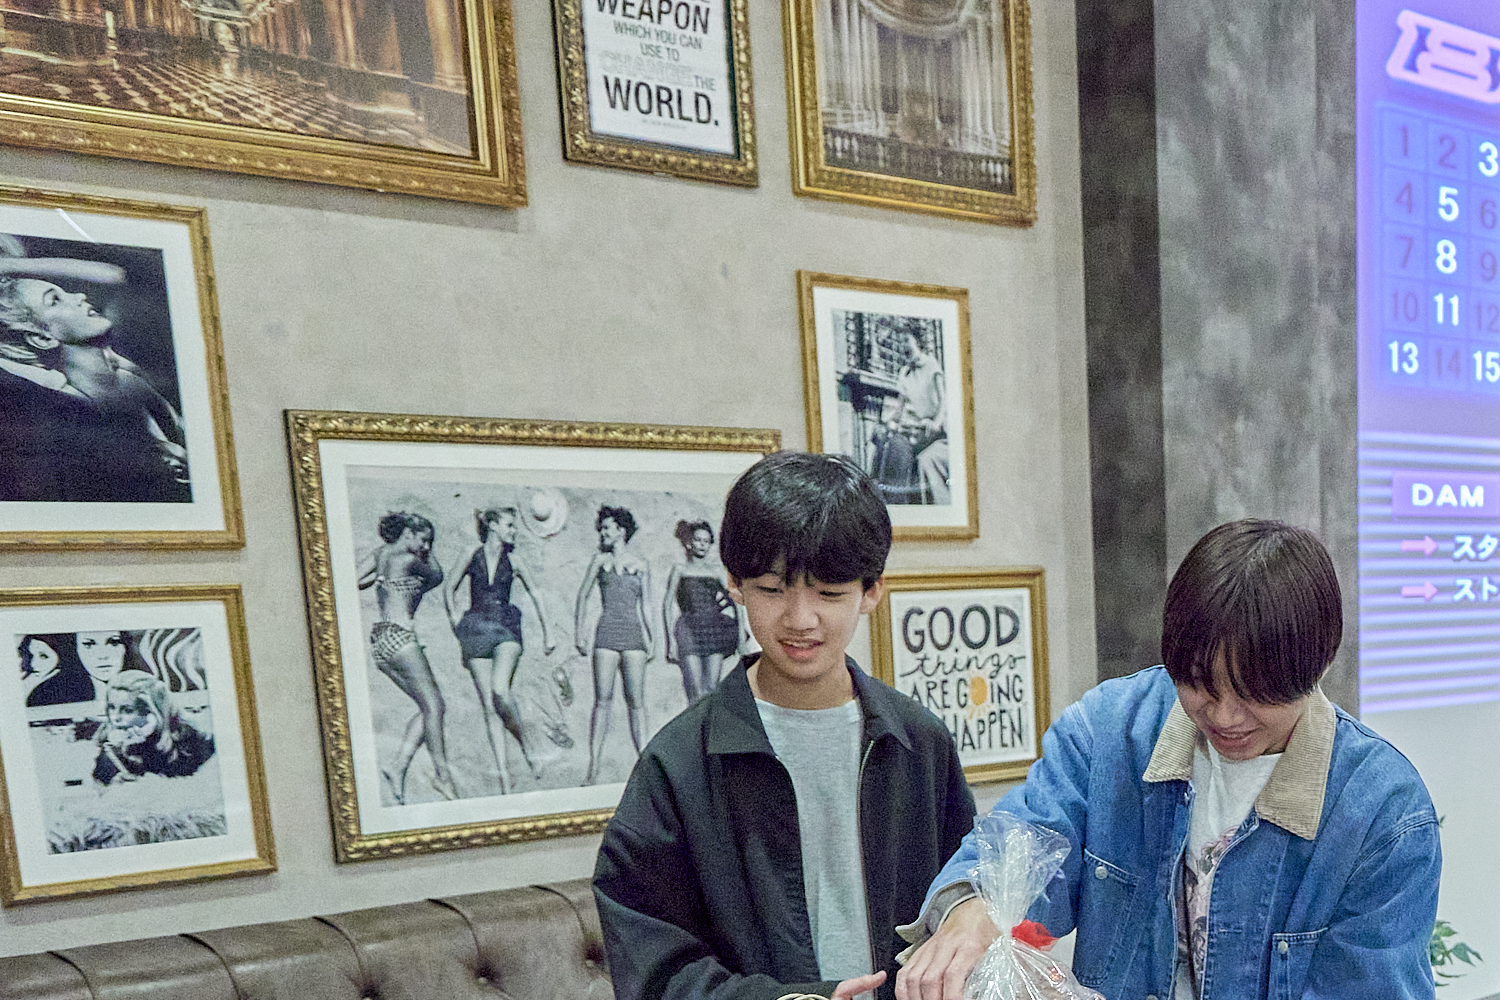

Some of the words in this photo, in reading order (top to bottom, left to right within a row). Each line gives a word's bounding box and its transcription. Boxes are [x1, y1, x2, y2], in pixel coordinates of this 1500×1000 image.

[614, 21, 651, 39] WHICH
[654, 29, 676, 45] YOU
[679, 35, 702, 49] CAN
[640, 43, 661, 59] USE
[666, 47, 680, 61] TO
[603, 75, 719, 126] WORLD.
[1401, 126, 1408, 156] 1
[1438, 134, 1457, 170] 2
[1478, 141, 1499, 177] 3
[1395, 182, 1413, 215] 4
[1438, 186, 1459, 221] 5
[1480, 200, 1497, 230] 6
[1397, 235, 1413, 269] 7
[1436, 239, 1457, 274] 8
[1481, 251, 1497, 282] 9
[1393, 291, 1418, 322] 10
[1433, 293, 1459, 326] 11
[1477, 303, 1500, 333] 12
[1388, 340, 1418, 374] 13
[1437, 348, 1460, 378] 14
[1473, 350, 1500, 383] 15
[1411, 483, 1484, 507] DAM
[902, 604, 1021, 653] GOOD
[911, 680, 951, 709] ARE
[943, 708, 1023, 751] HAPPEN
